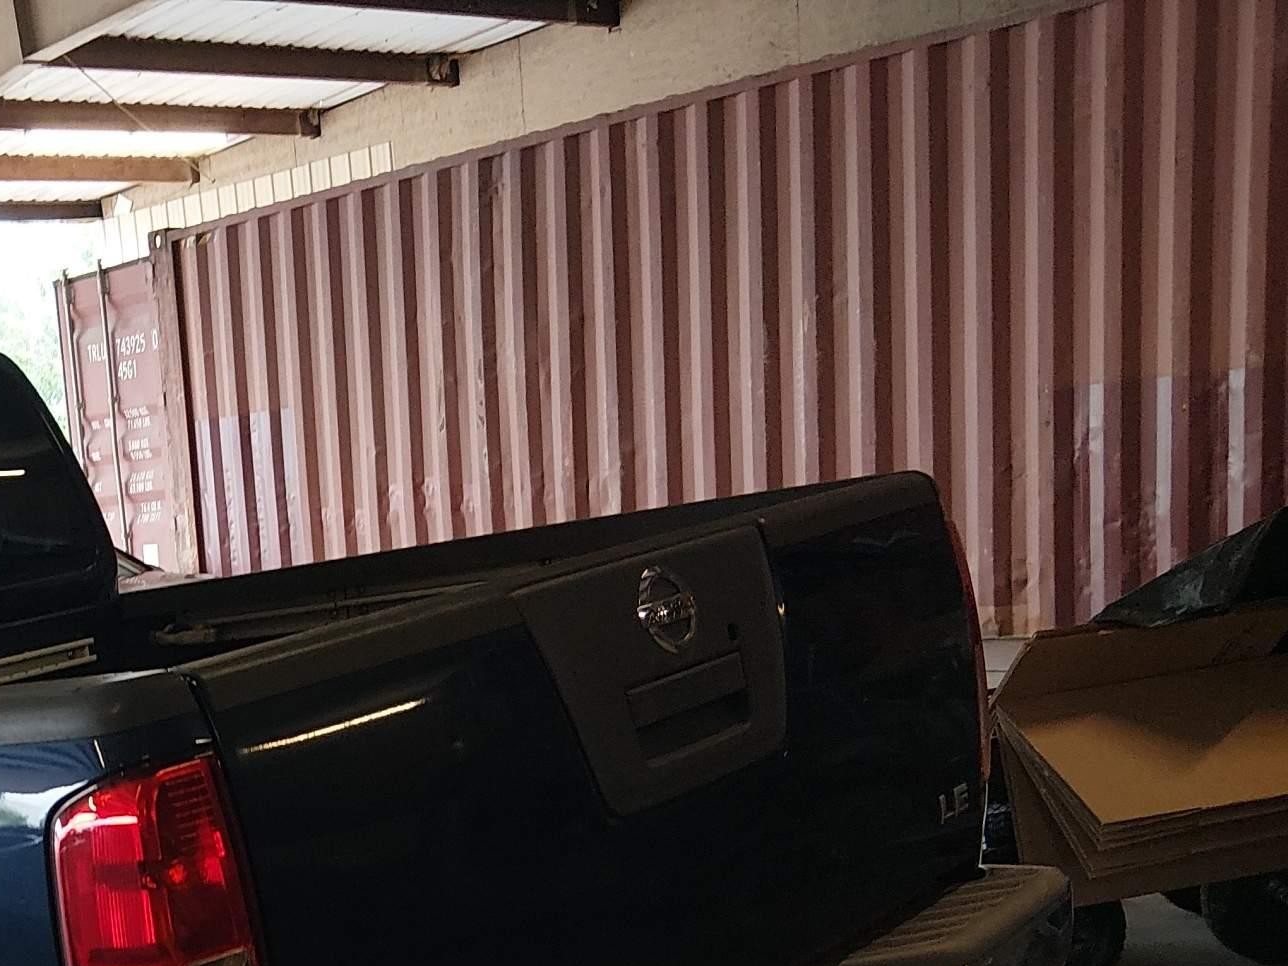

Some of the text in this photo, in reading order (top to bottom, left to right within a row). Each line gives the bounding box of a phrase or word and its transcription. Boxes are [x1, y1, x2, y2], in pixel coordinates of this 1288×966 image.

[87, 343, 108, 363] TRLU
[115, 332, 146, 358] 743925
[118, 358, 137, 380] 45G1
[938, 781, 970, 825] LE
